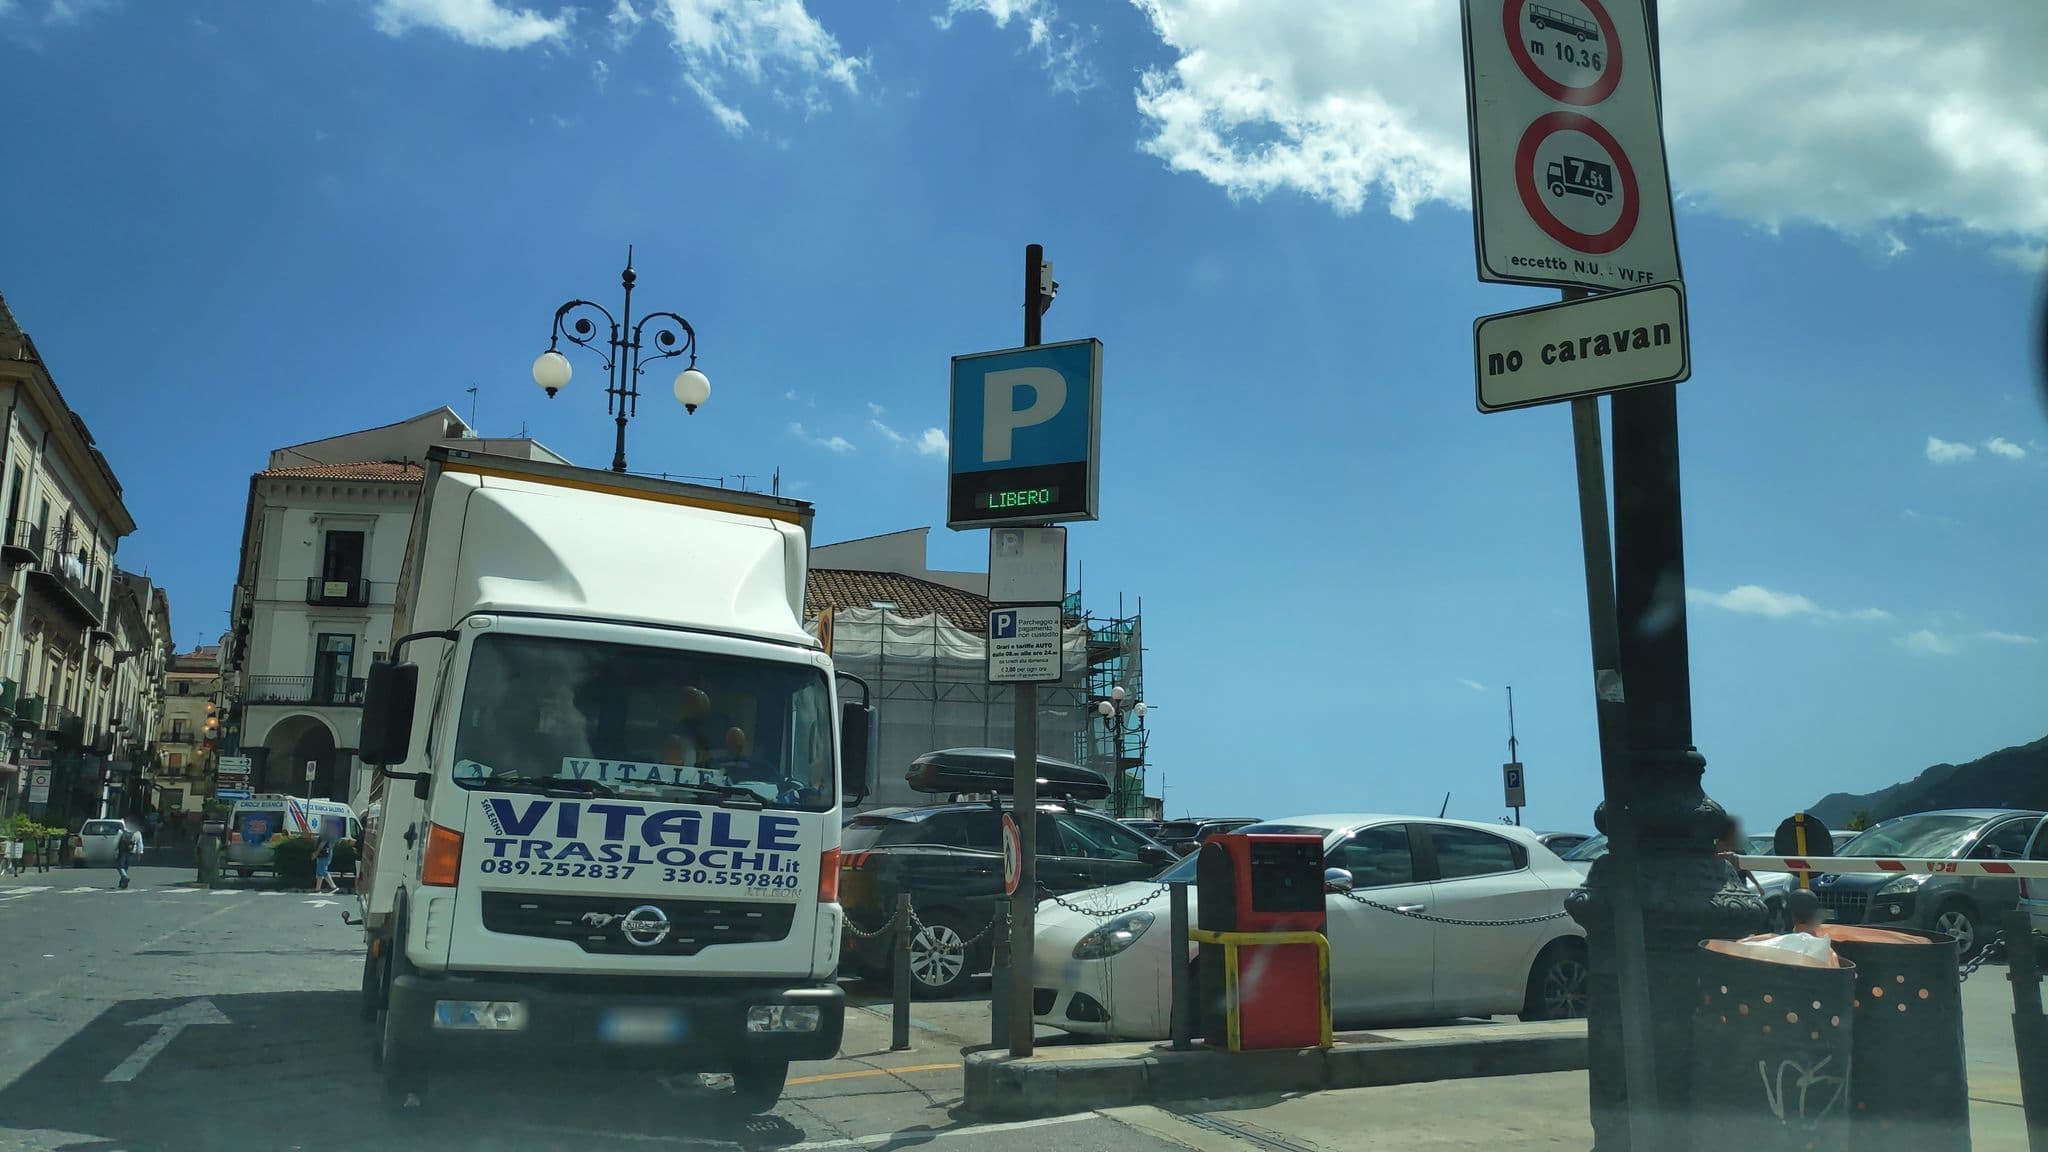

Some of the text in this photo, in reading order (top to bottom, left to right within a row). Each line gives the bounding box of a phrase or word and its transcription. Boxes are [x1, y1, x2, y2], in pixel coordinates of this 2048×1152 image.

[1530, 39, 1601, 72] m 10.36
[1570, 160, 1604, 188] 7.5t
[1511, 255, 1567, 271] eccetto
[1488, 322, 1671, 376] no caravan
[982, 366, 1067, 463] P
[989, 488, 1049, 509] LIBERO
[997, 614, 1011, 636] P
[570, 760, 714, 785] VITALE
[481, 799, 503, 836] SALERNO
[486, 798, 801, 851] VITALE
[480, 858, 798, 889] 089.252837 330.559840
